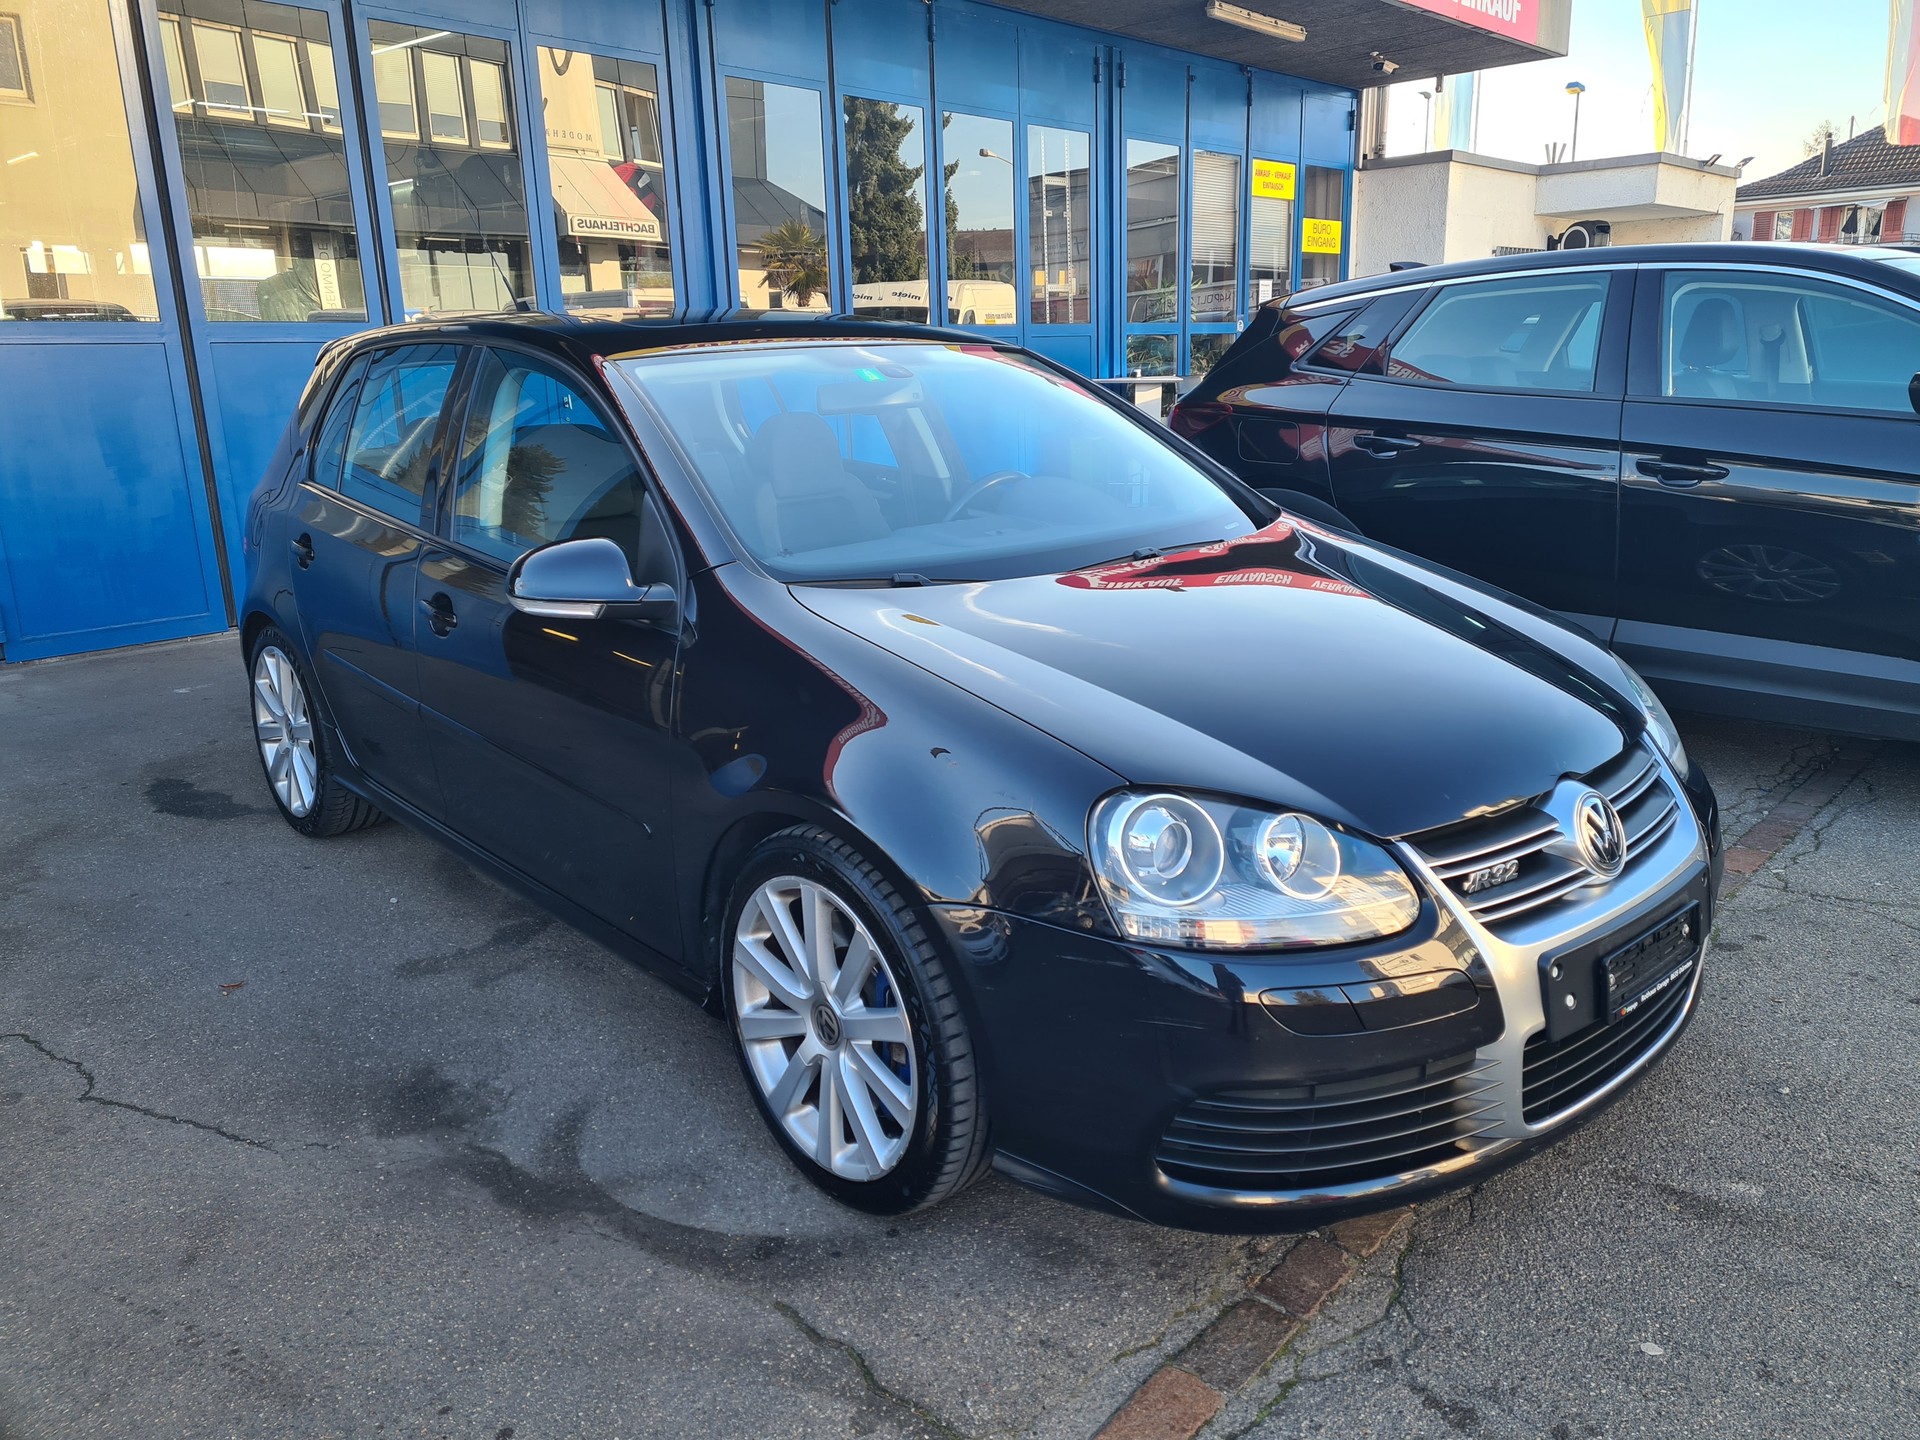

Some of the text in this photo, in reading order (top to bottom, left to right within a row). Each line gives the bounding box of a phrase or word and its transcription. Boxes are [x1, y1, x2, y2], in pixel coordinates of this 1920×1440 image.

[1255, 169, 1271, 177] ANKAUF
[1274, 171, 1292, 180] VERKAUF
[1262, 181, 1284, 191] EINTAUSCH
[1312, 221, 1332, 235] BÜRO
[1307, 236, 1336, 248] EINGANG
[1463, 859, 1520, 894] R32
